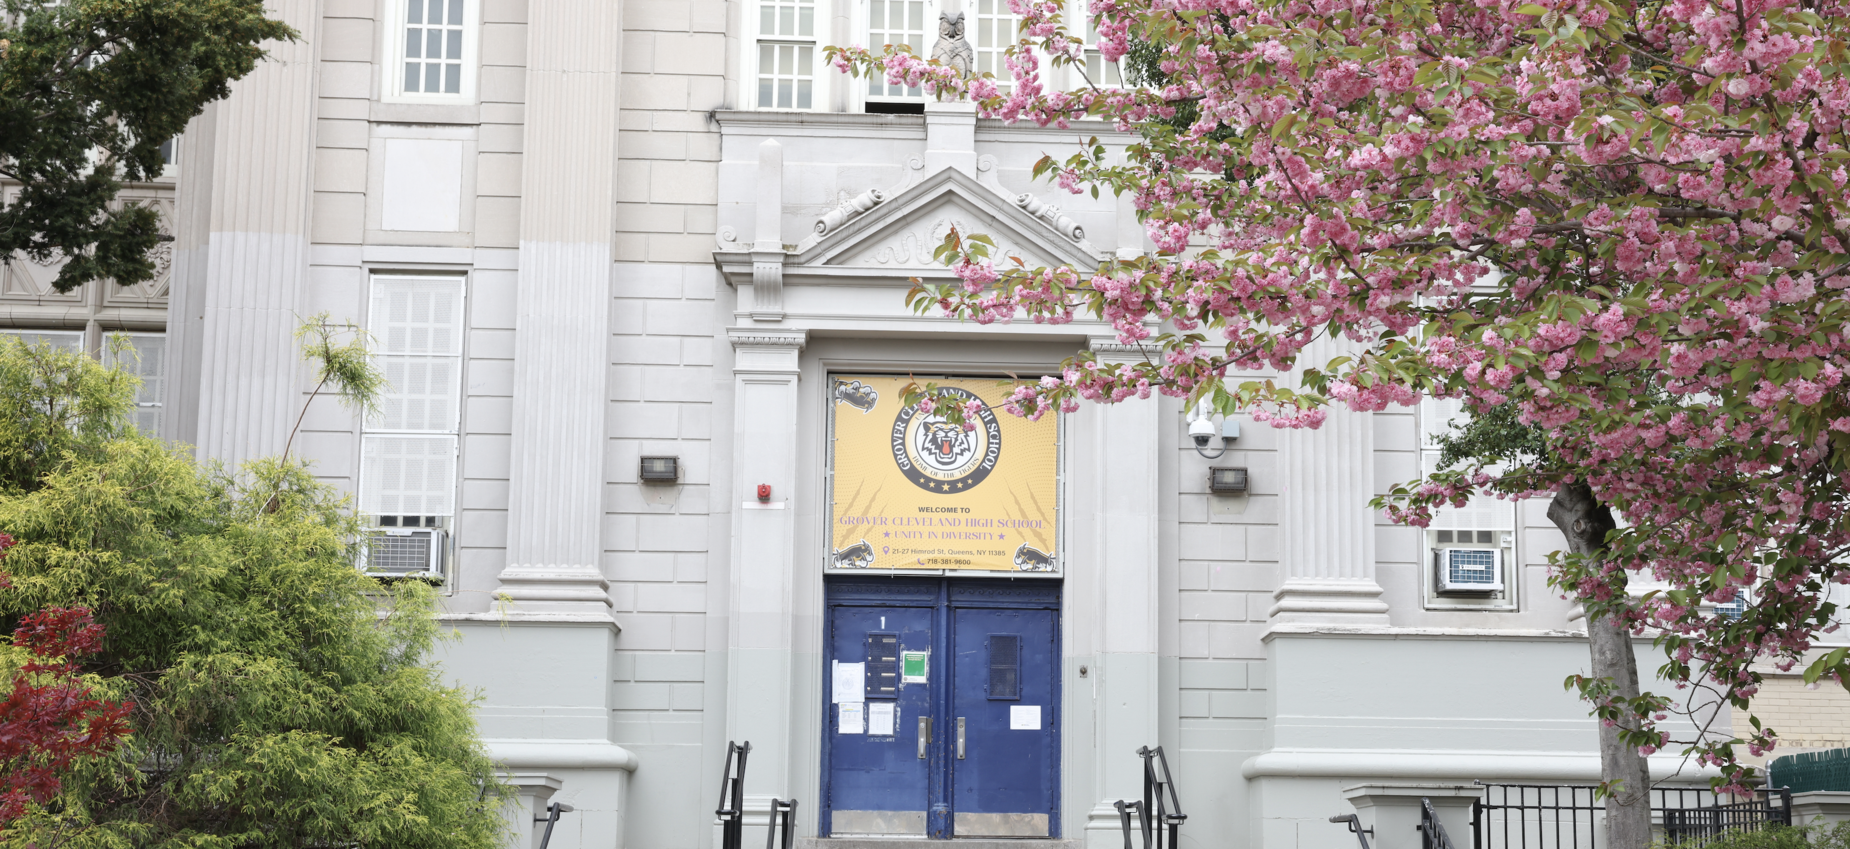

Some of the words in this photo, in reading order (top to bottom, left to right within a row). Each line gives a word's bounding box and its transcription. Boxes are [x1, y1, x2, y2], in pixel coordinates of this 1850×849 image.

[893, 421, 911, 470] GROVER
[980, 423, 1000, 470] SCHOOL
[912, 455, 928, 474] HOME
[930, 470, 940, 478] OF
[958, 457, 980, 476] TIGERS
[839, 516, 888, 526] GROVER
[892, 517, 961, 527] CLEVELAND
[965, 518, 993, 528] HIGH
[997, 519, 1046, 529] SCHOOL
[894, 531, 924, 539] UNITY
[928, 531, 938, 539] IN
[941, 531, 995, 540] DIVERSITY
[880, 616, 885, 629] 1
